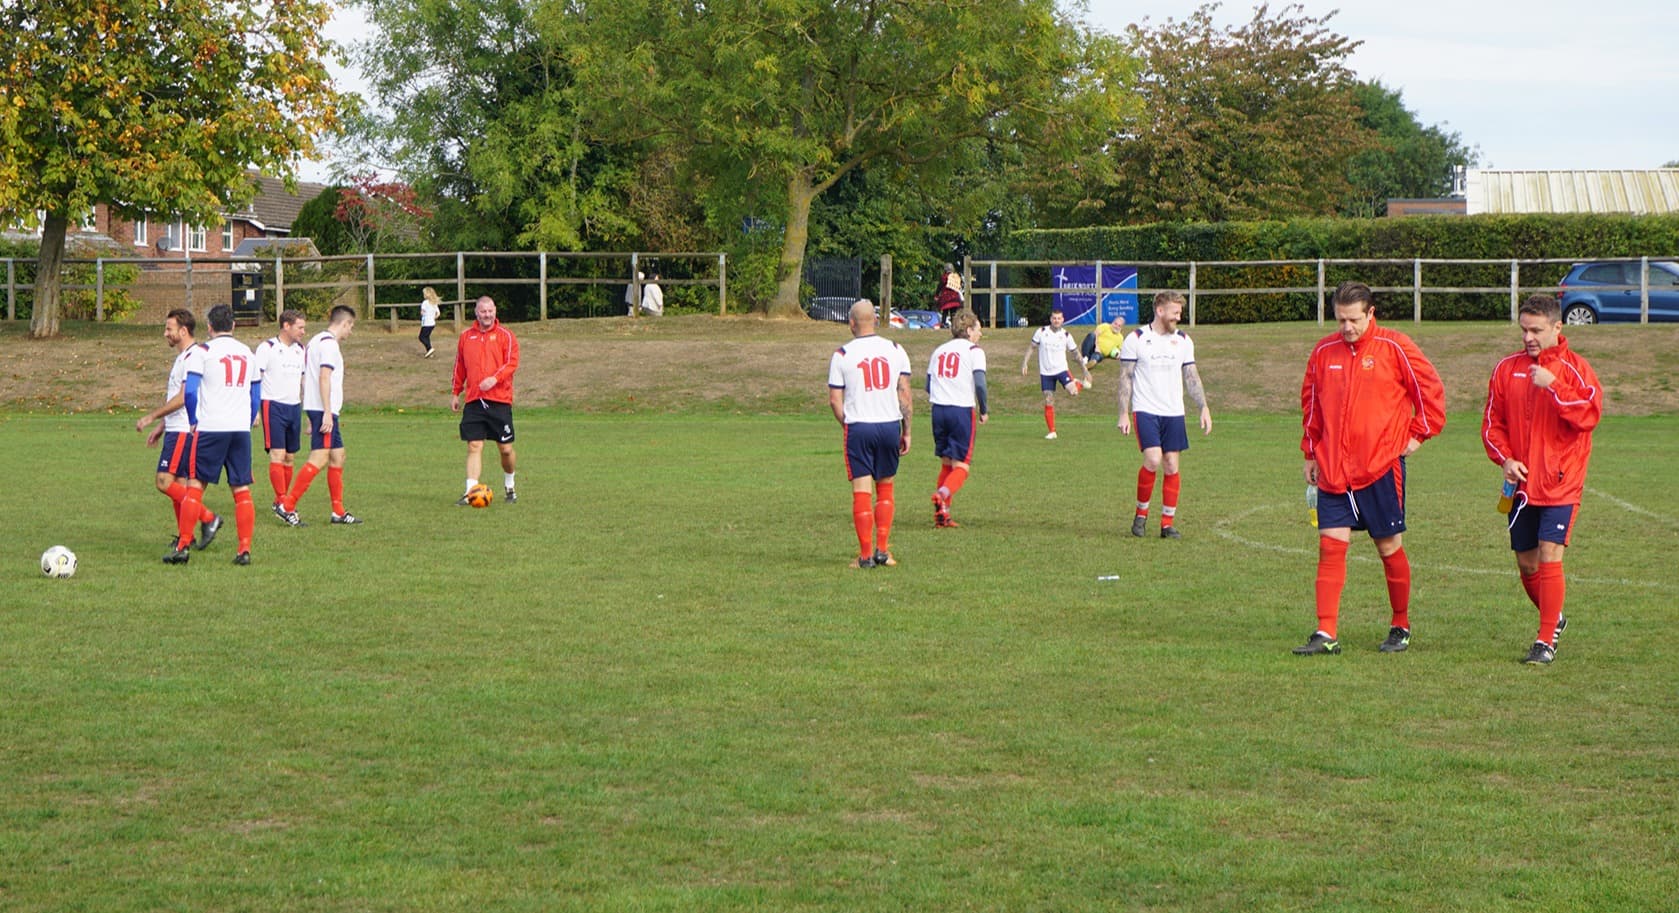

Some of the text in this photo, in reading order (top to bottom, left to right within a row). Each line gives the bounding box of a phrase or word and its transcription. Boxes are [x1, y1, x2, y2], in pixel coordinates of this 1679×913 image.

[219, 354, 248, 388] 17
[857, 356, 890, 392] 10
[937, 352, 961, 379] 19
